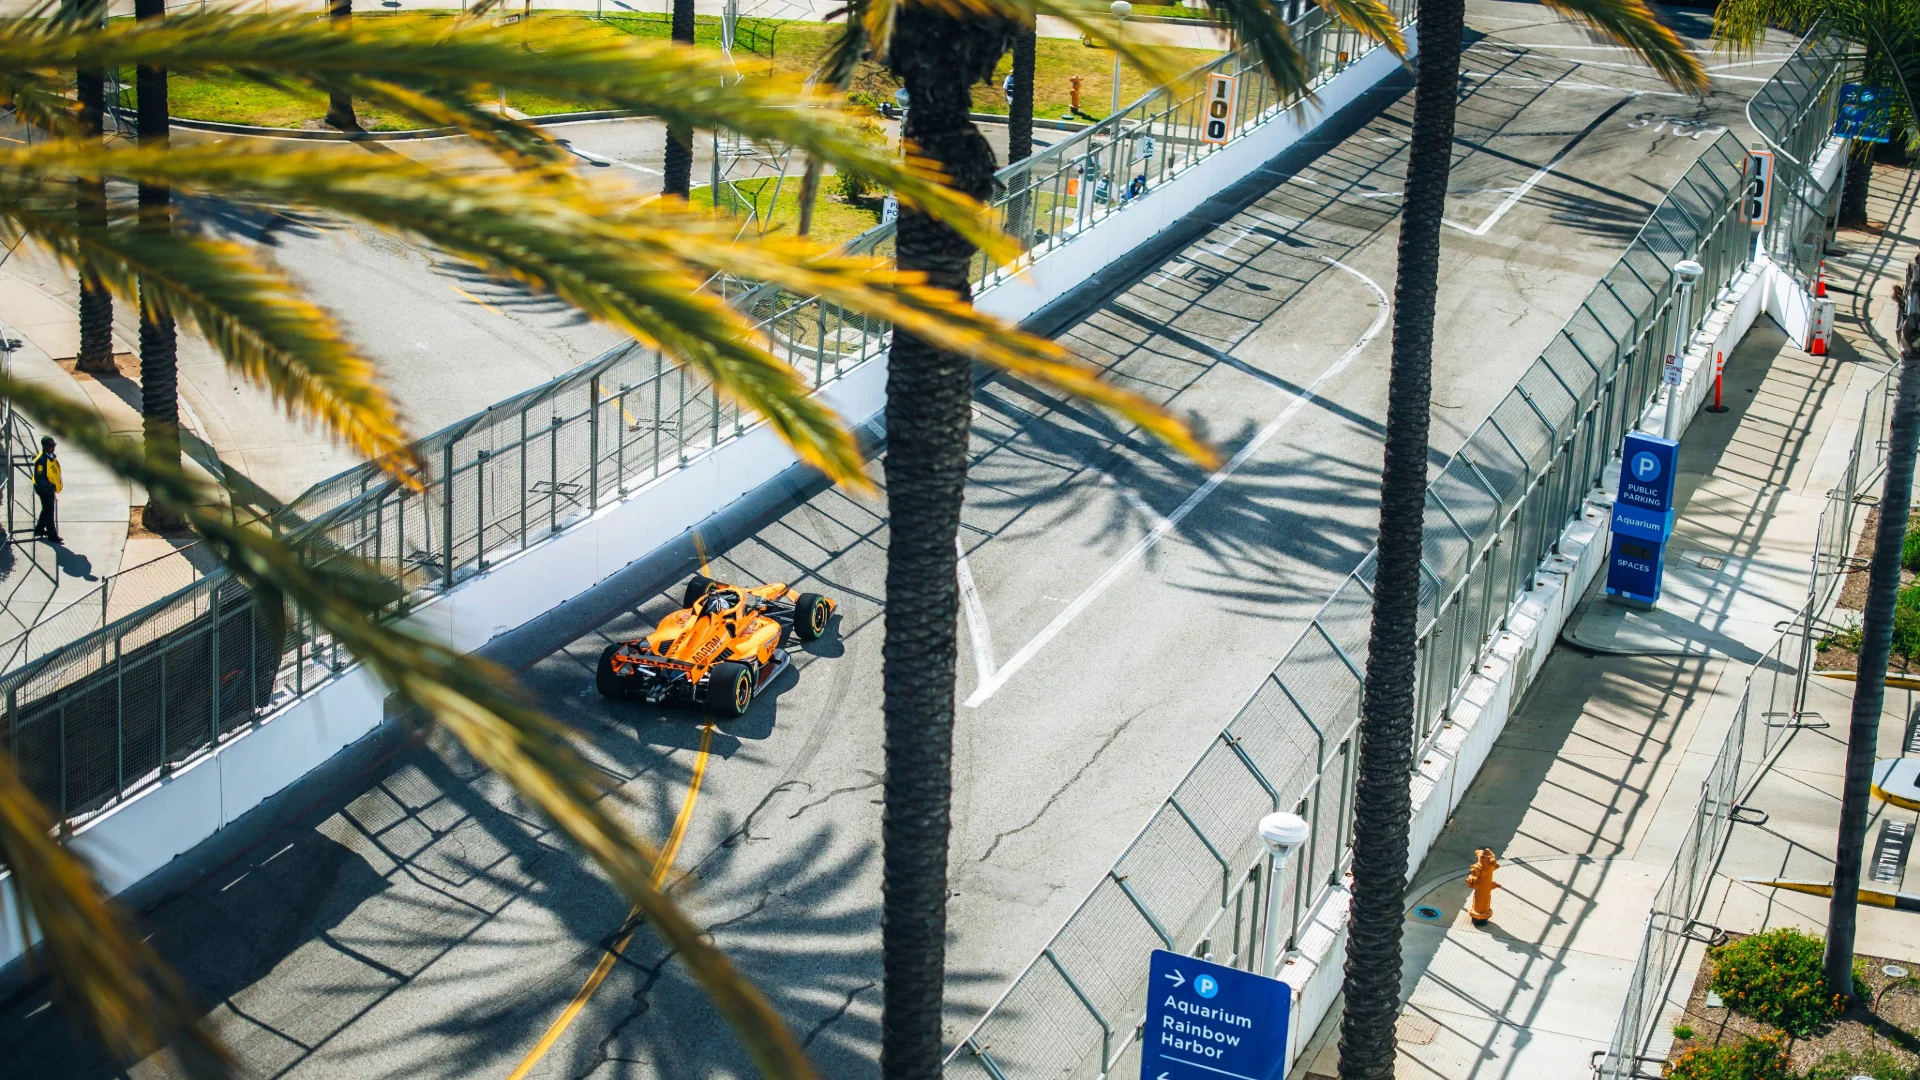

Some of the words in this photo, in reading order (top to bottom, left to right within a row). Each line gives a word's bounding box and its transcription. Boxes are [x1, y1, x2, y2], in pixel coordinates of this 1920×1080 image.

[1208, 80, 1228, 139] 100
[1744, 156, 1765, 219] 100
[1638, 457, 1655, 477] P
[1623, 492, 1661, 506] PARKING
[1627, 483, 1658, 497] PUBLIC
[1616, 514, 1660, 531] Aquarium
[1617, 559, 1650, 572] SPACES
[1887, 820, 1907, 836] NOT
[1200, 978, 1214, 994] P
[1164, 995, 1252, 1028] Aquarium
[1162, 1015, 1241, 1047] Rainbow
[1161, 1032, 1224, 1059] Harbor
